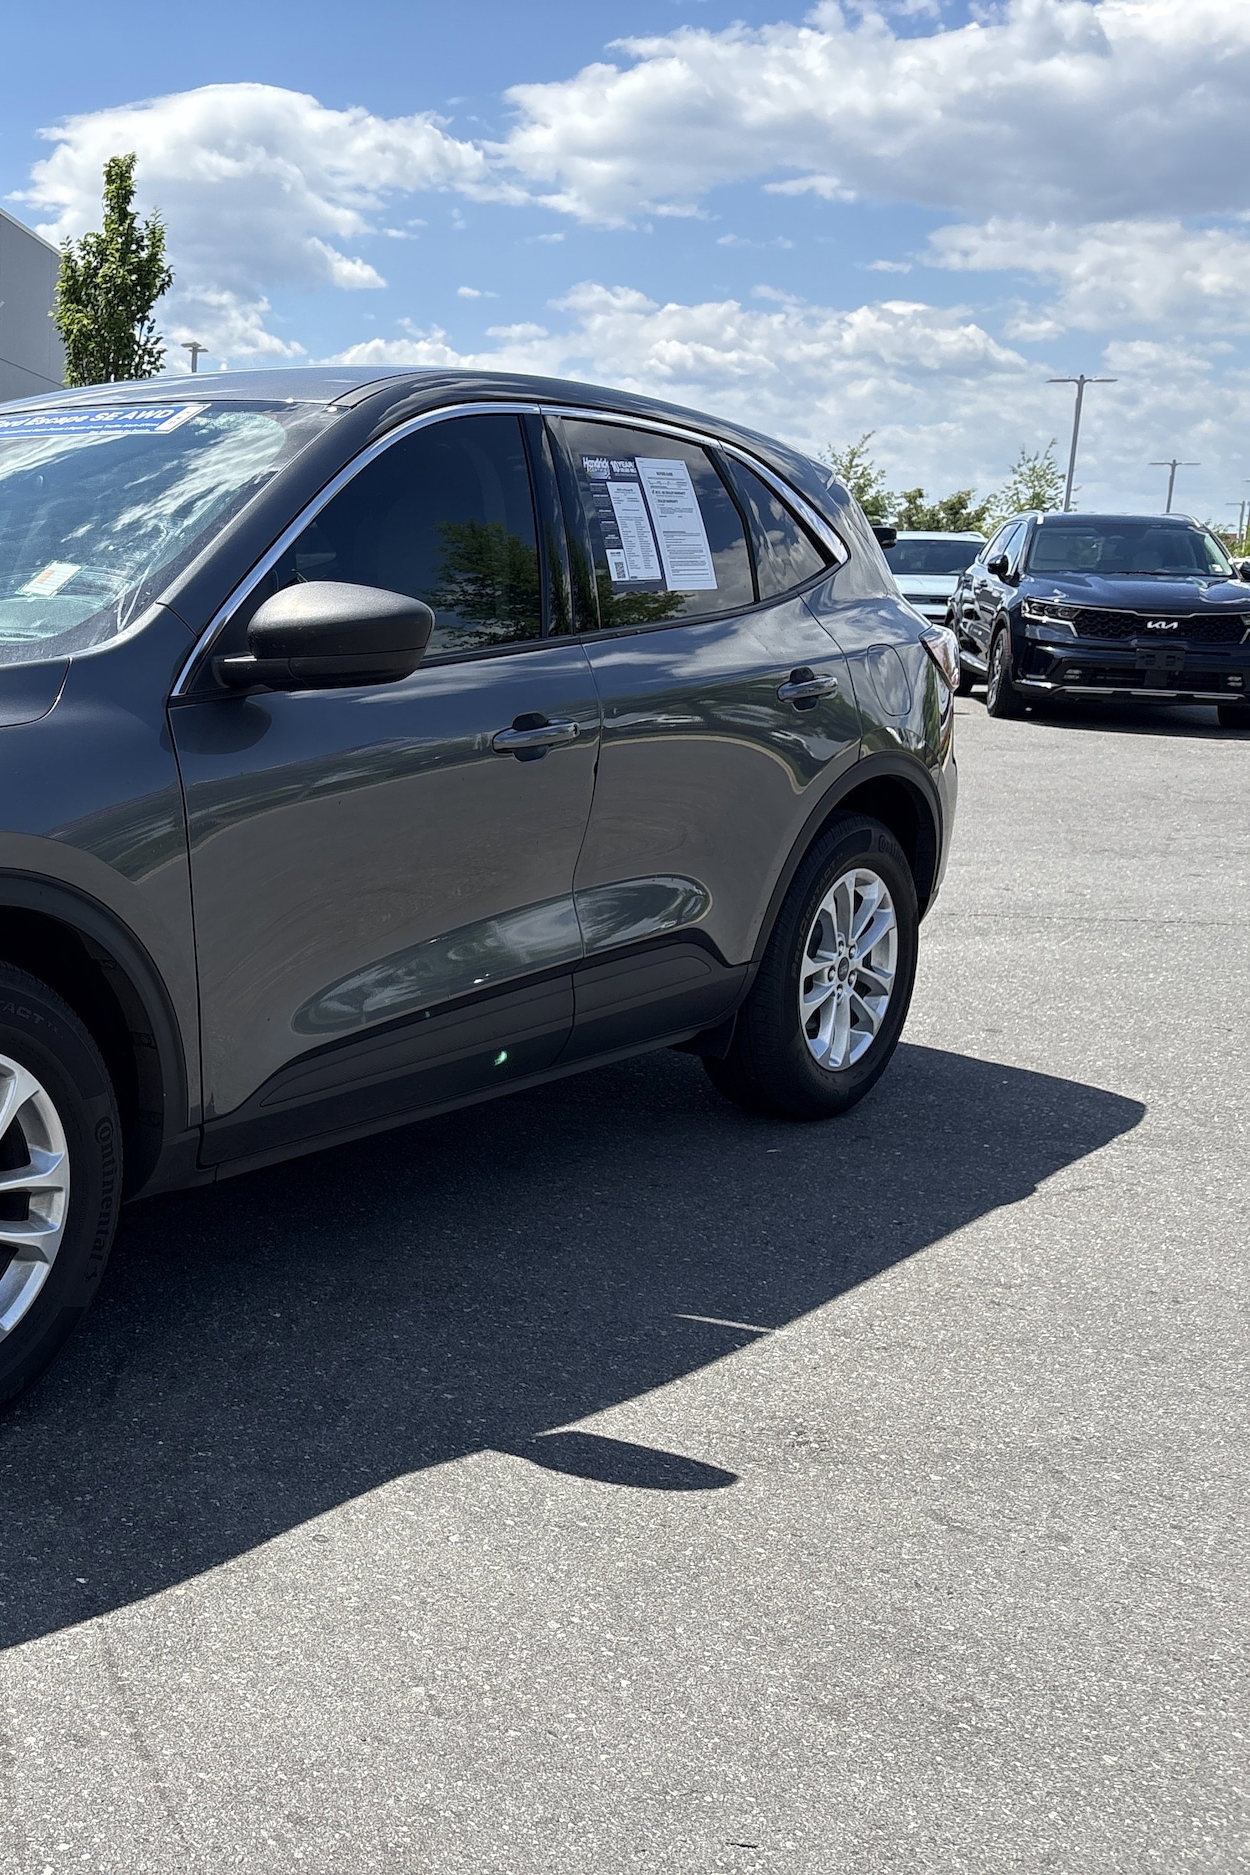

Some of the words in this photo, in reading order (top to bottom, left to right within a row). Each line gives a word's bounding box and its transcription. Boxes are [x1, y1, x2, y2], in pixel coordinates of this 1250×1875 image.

[24, 415, 90, 427] Escape
[90, 411, 124, 422] SE
[118, 409, 175, 420] AWD
[91, 1116, 117, 1262] Continental
